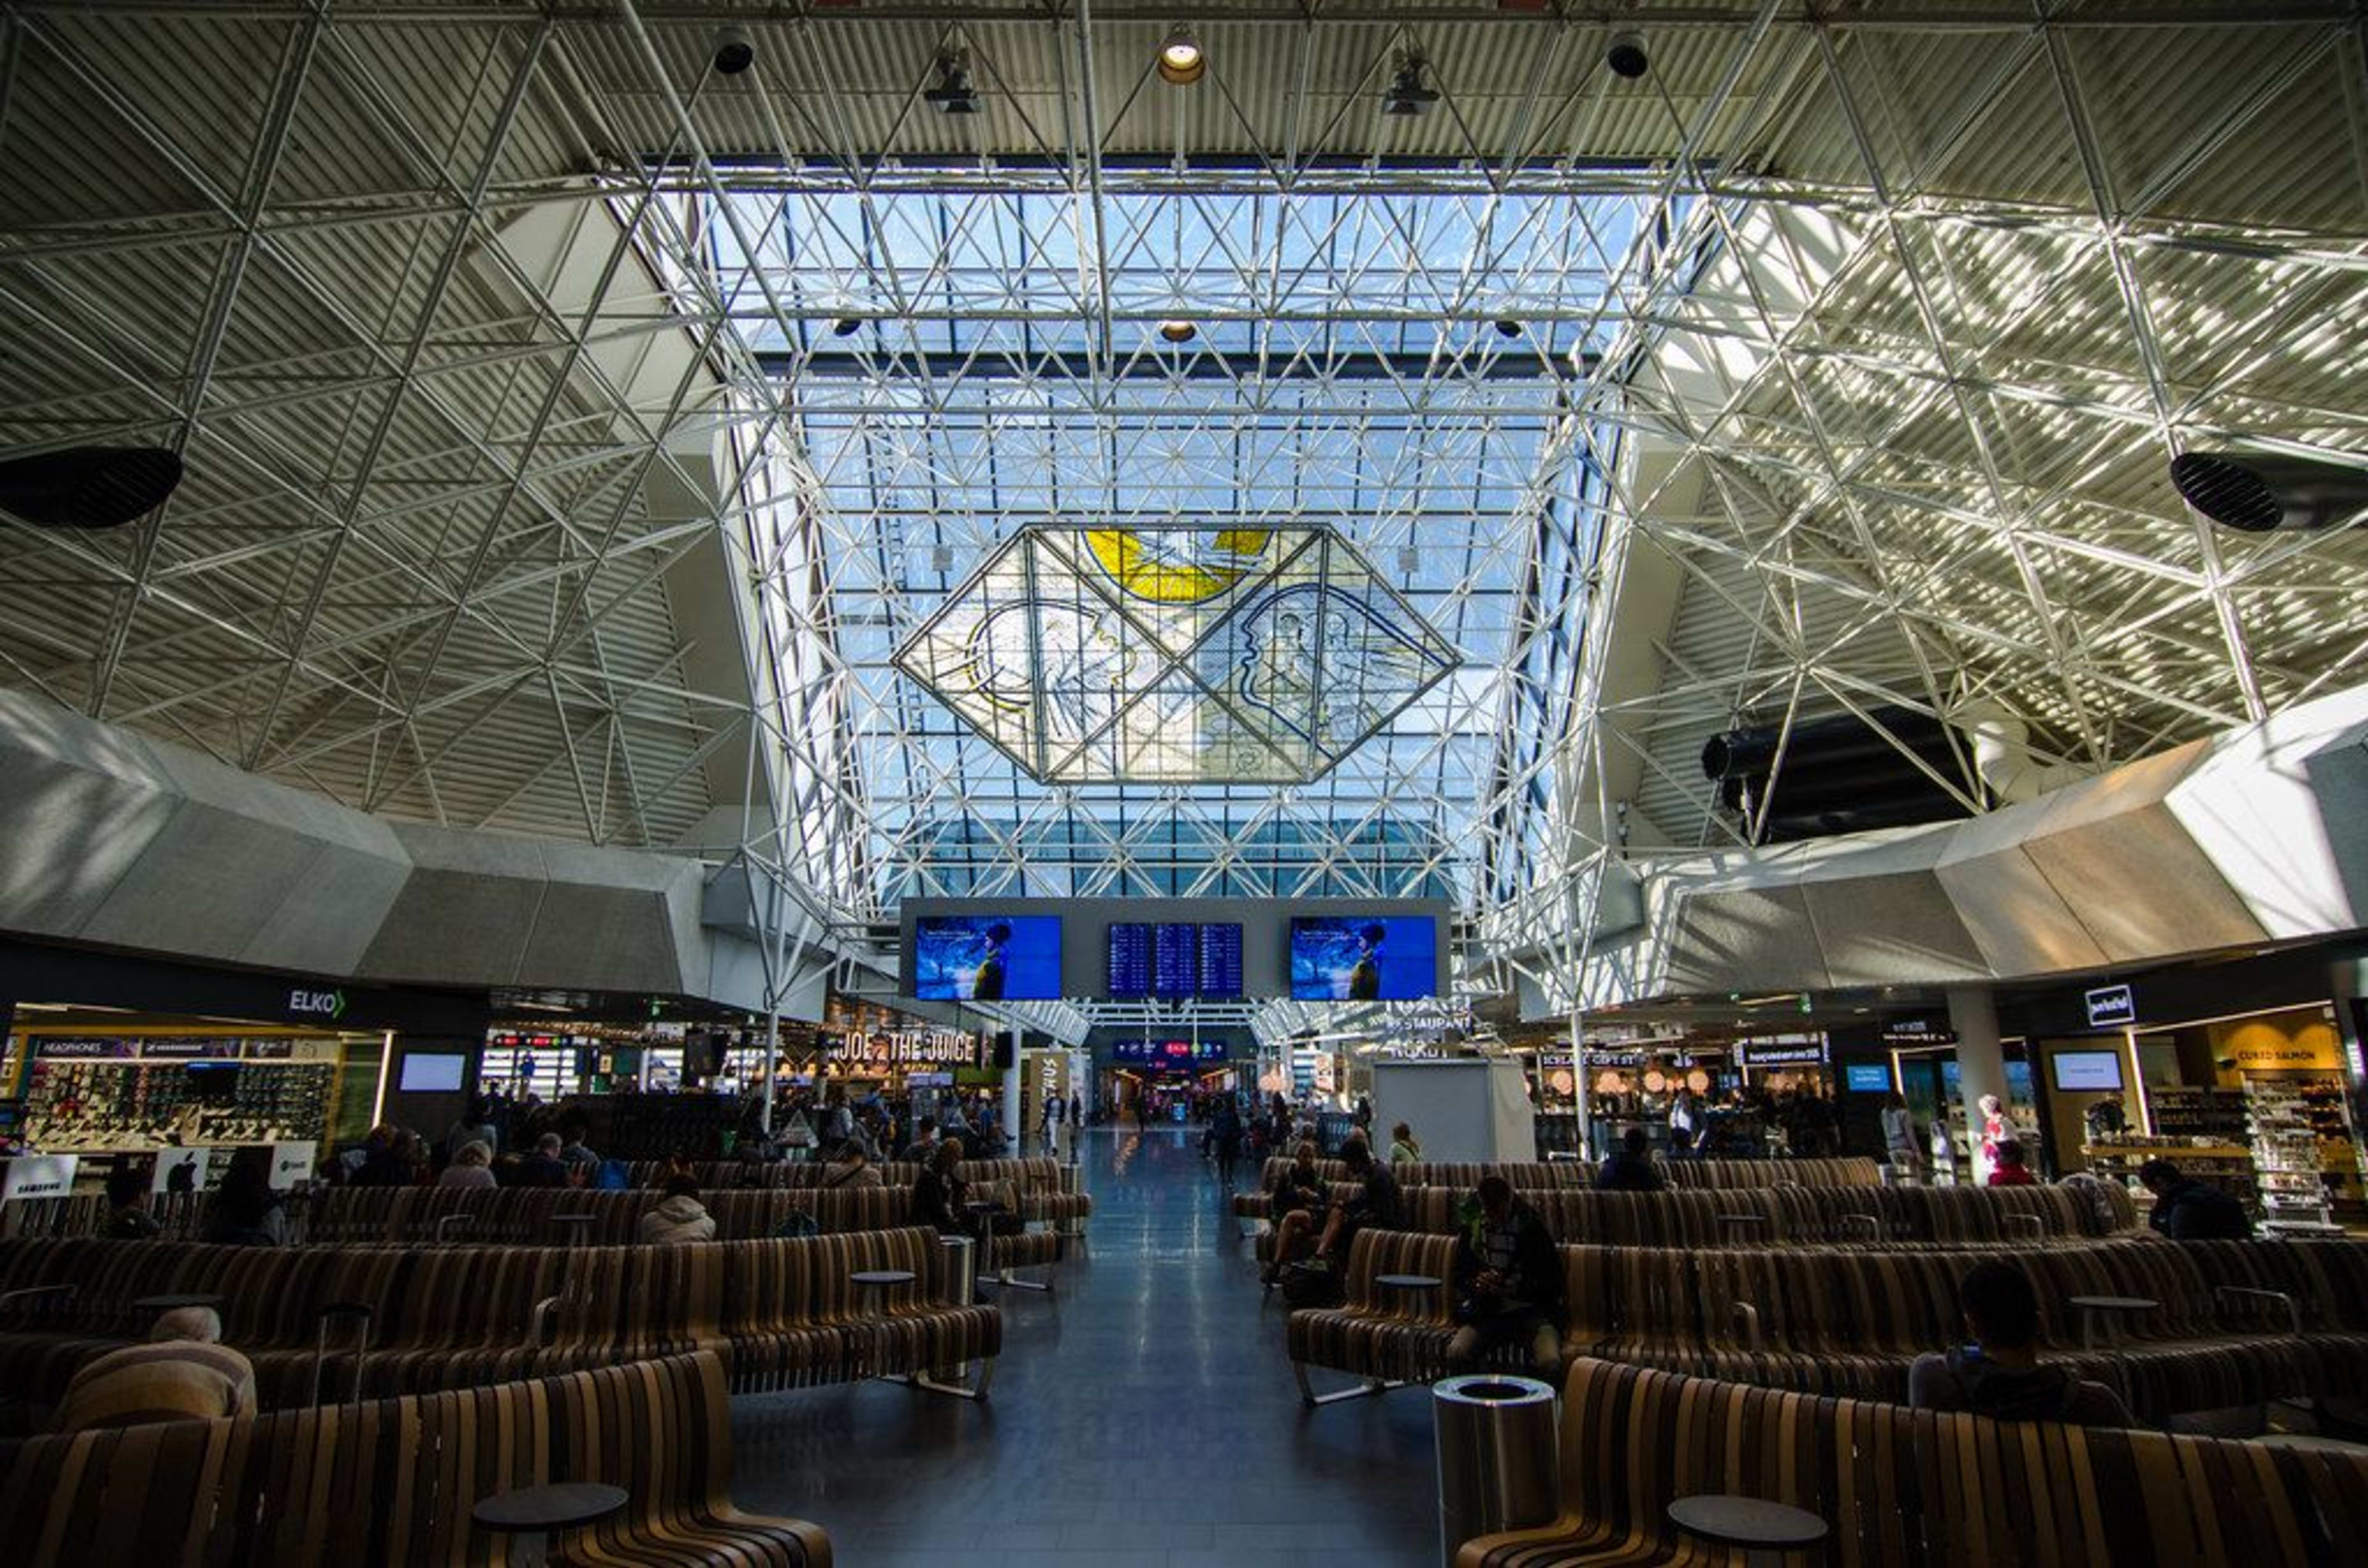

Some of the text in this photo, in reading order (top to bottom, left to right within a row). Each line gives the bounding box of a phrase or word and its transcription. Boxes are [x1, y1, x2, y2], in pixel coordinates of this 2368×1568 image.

[290, 990, 336, 1012] ELKO
[43, 1042, 102, 1053] HEADPHONES
[839, 1031, 874, 1061] JOE
[889, 1033, 923, 1061] THE
[926, 1033, 975, 1062] JUICE
